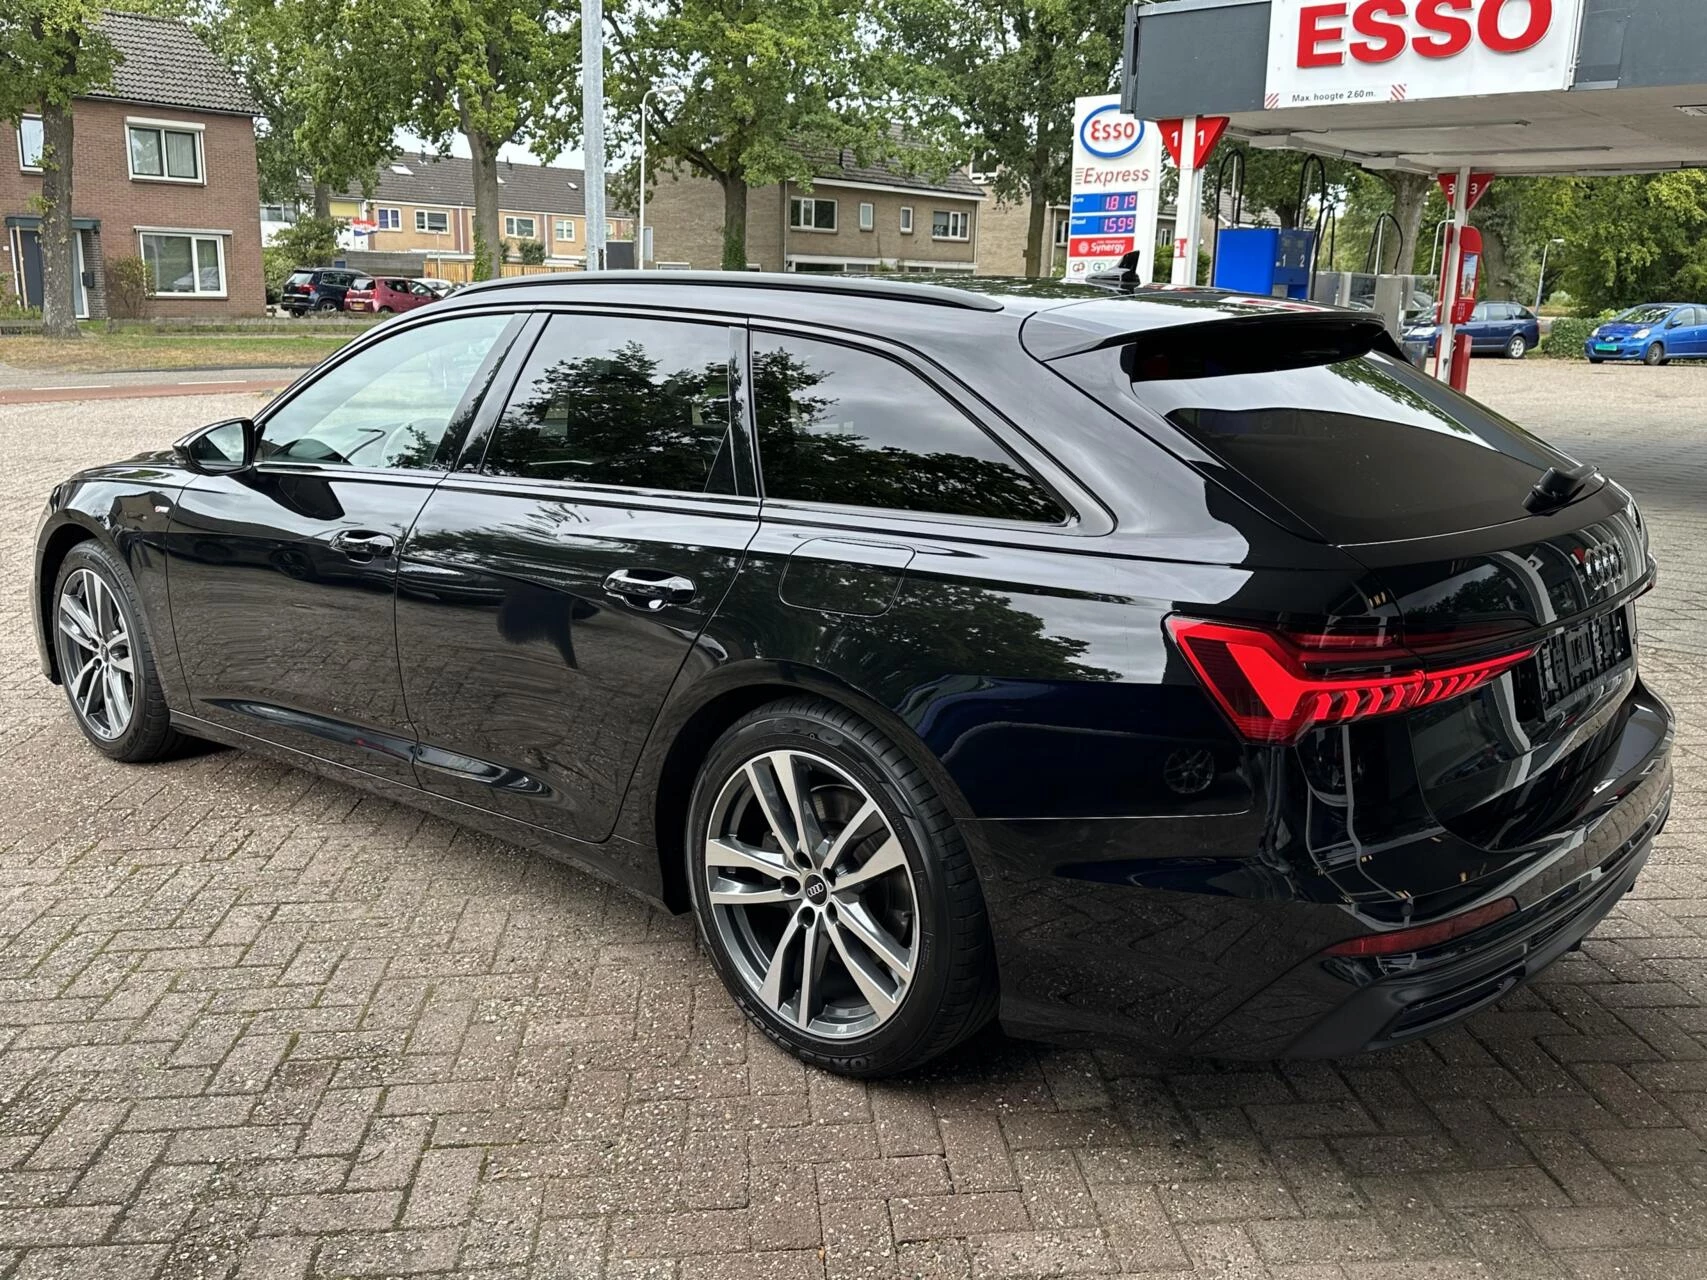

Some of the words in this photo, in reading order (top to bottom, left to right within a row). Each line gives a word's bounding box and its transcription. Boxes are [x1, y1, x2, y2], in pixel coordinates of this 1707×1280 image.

[1297, 0, 1553, 68] ESSO
[1313, 92, 1344, 102] hoogte
[1171, 131, 1179, 147] 1
[1197, 129, 1205, 146] 1
[1083, 167, 1151, 187] Express
[1447, 183, 1456, 195] 3
[1470, 182, 1478, 194] 3
[1091, 243, 1125, 253] Synergy
[1282, 254, 1287, 268] 1
[1299, 254, 1305, 268] 2
